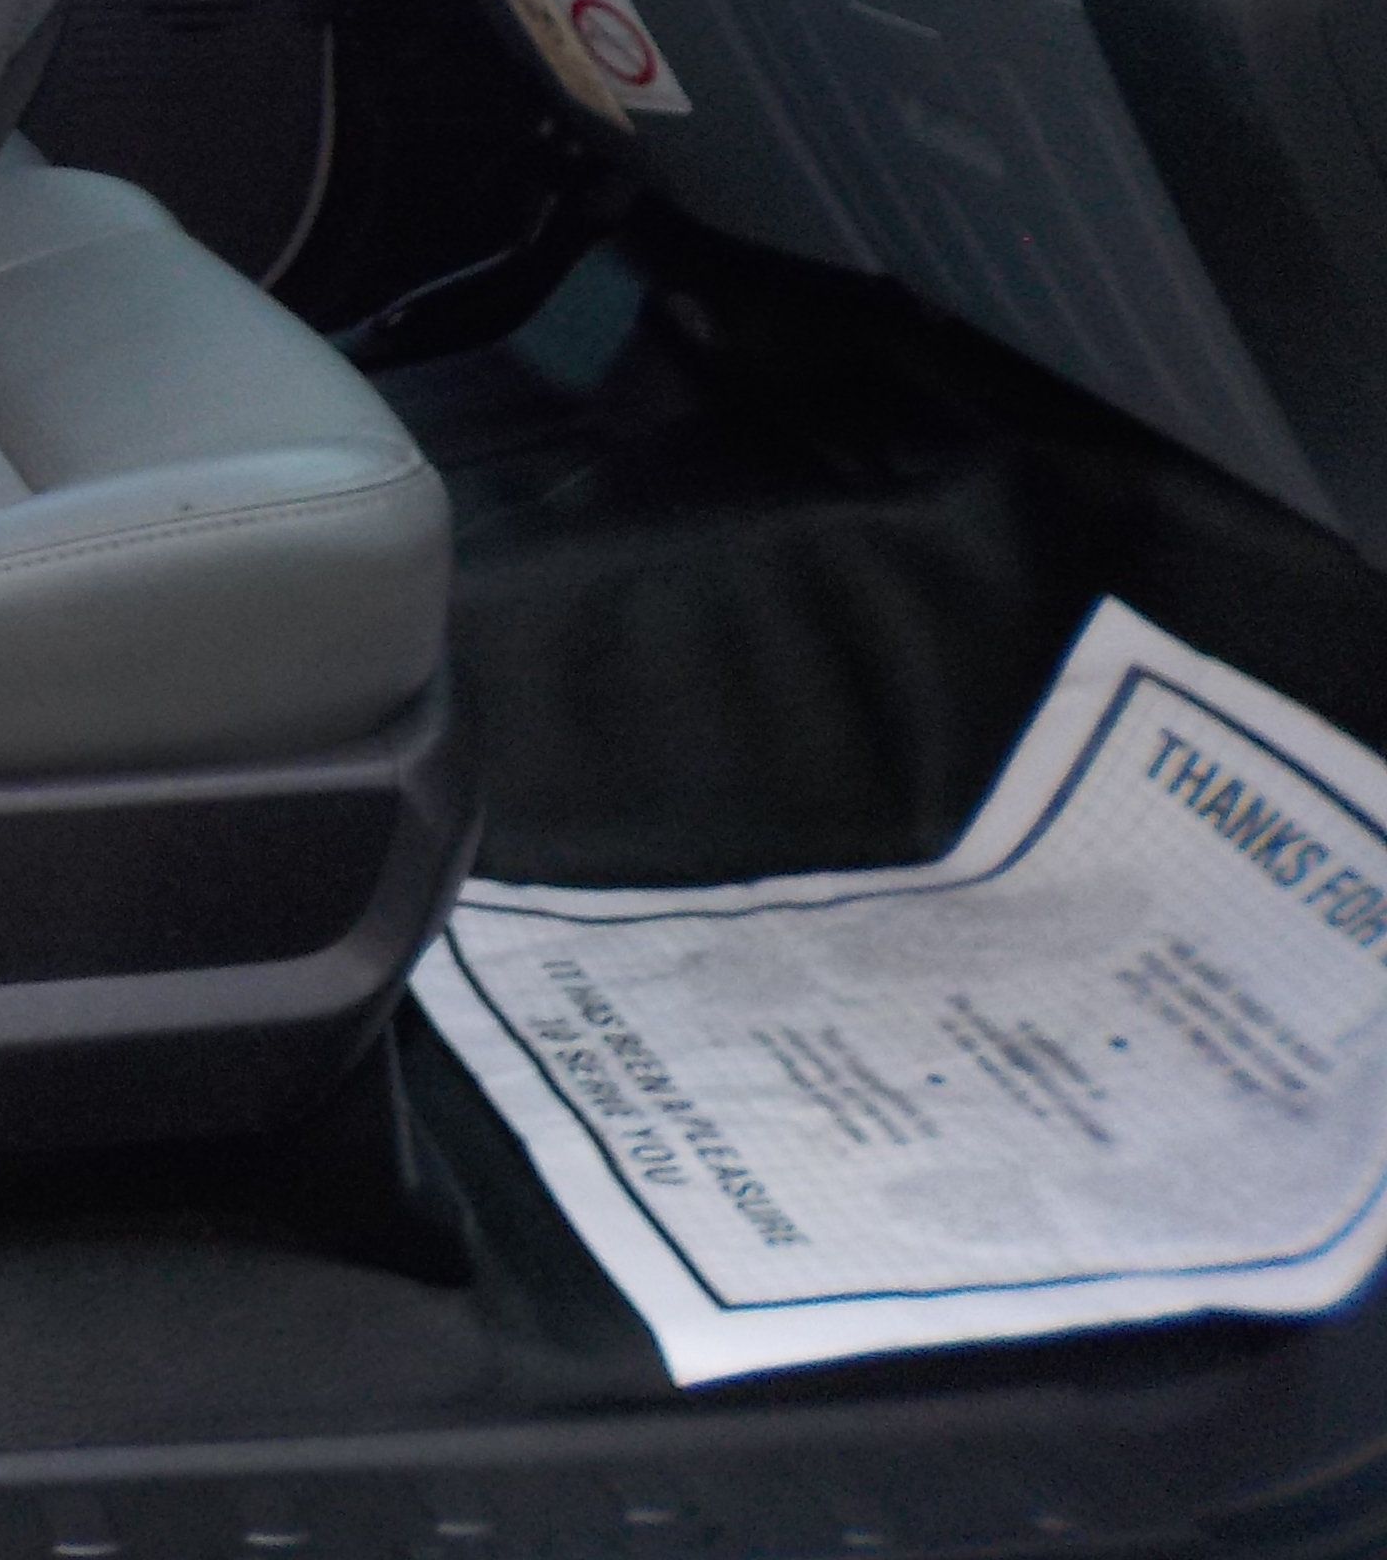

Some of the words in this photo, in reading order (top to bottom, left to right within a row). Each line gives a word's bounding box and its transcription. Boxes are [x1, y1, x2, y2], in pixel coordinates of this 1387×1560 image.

[1147, 727, 1330, 889] THANKS
[620, 1128, 693, 1186] YOU
[671, 1114, 813, 1246] PLEASURE
